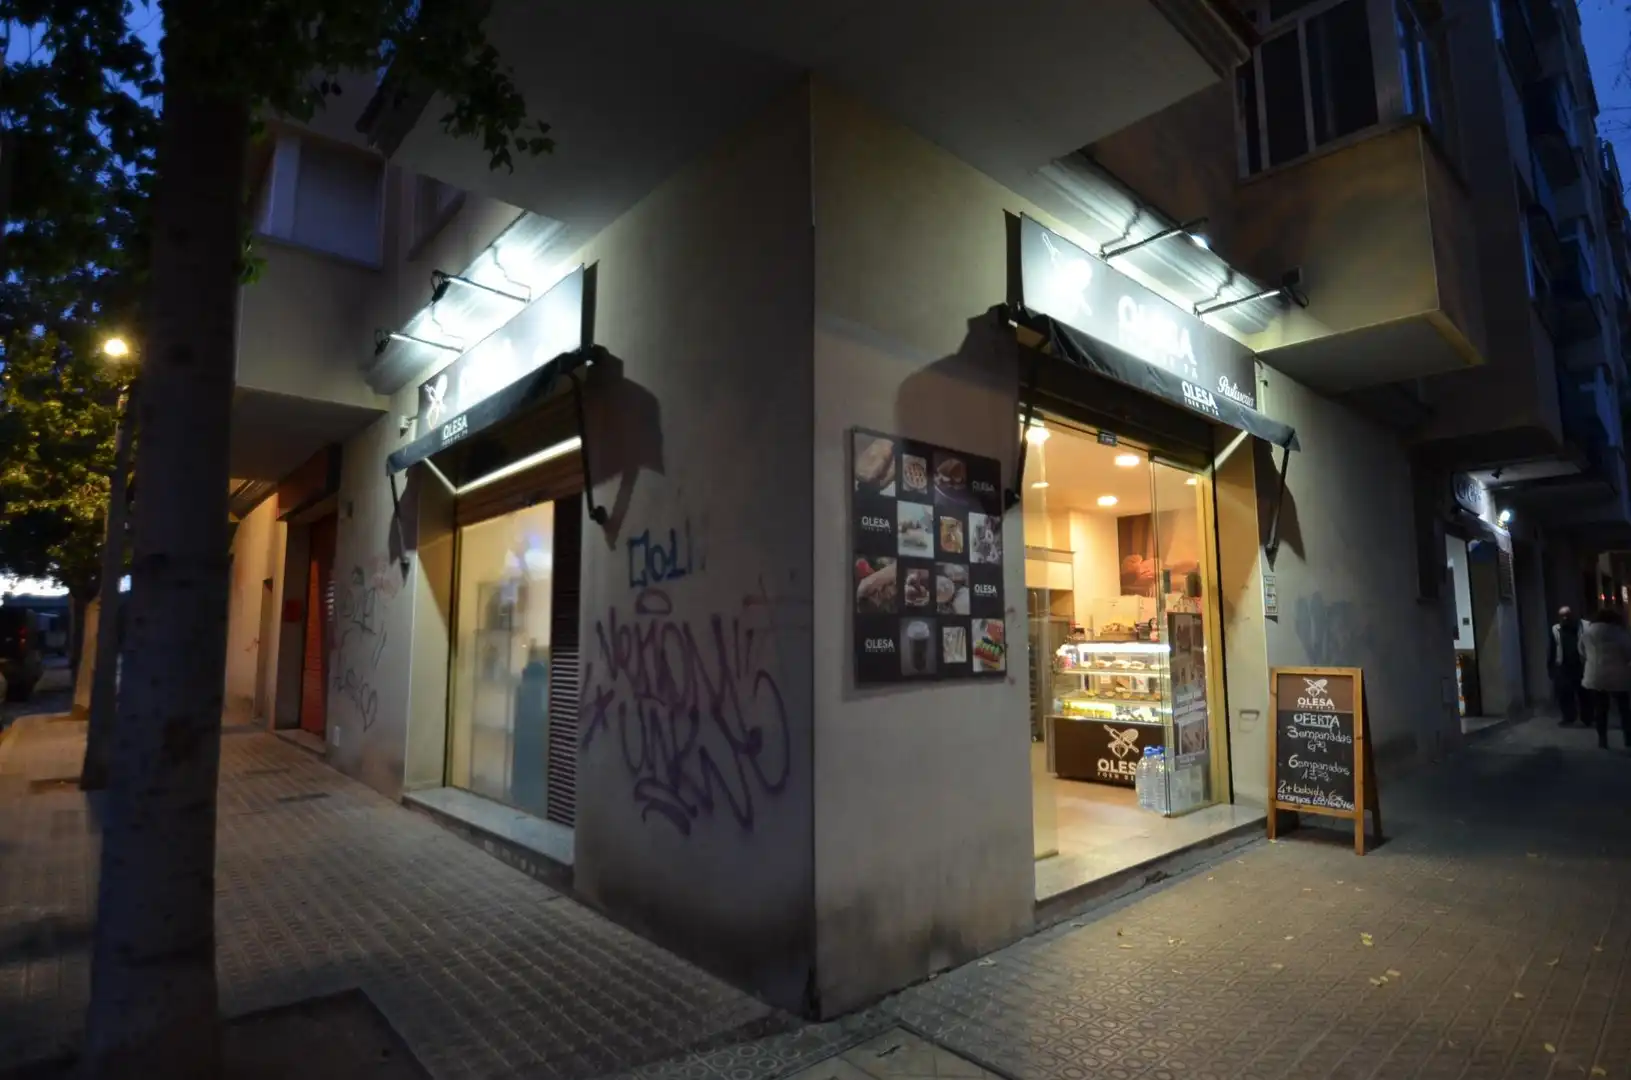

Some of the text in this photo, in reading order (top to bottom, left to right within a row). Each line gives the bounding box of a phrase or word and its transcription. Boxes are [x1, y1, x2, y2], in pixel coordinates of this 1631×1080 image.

[1181, 381, 1218, 410] OLESA
[443, 414, 468, 440] OLESA
[862, 515, 890, 529] OLESA
[974, 584, 997, 594] OLESA
[865, 638, 894, 649] OLESA
[1297, 697, 1335, 707] OLESA
[1293, 713, 1340, 728] OFERTA
[1097, 758, 1136, 775] OLES
